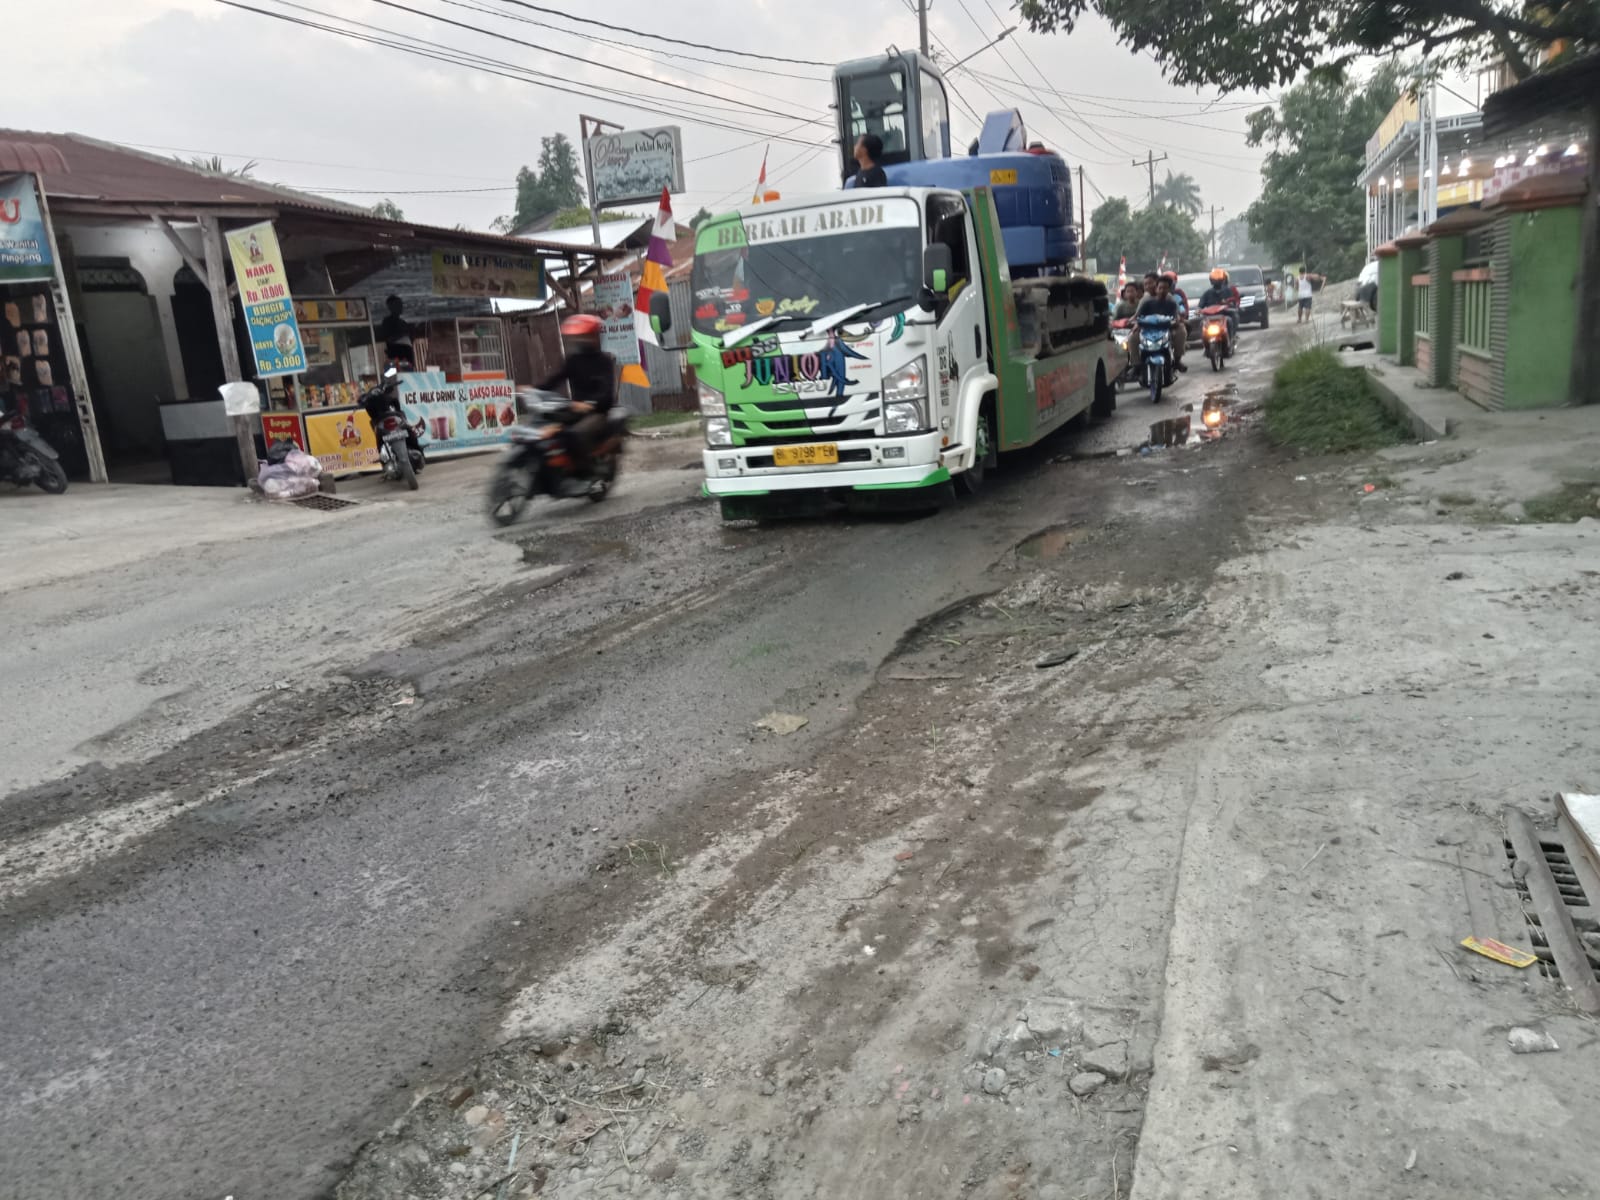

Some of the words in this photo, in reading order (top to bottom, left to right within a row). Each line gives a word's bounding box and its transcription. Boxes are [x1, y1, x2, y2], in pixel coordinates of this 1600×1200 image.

[718, 216, 806, 247] BERKAH
[814, 205, 884, 232] ABADI
[246, 264, 275, 279] HANYA
[261, 284, 285, 300] 10.000
[275, 355, 300, 369] 5.000
[740, 350, 860, 393] JUNIOR
[405, 391, 417, 404] ICE
[420, 390, 436, 403] MILK
[436, 390, 456, 402] DRINK
[469, 386, 490, 400] BAKSO
[491, 384, 512, 398] BAKAR
[772, 382, 828, 395] ISUZU
